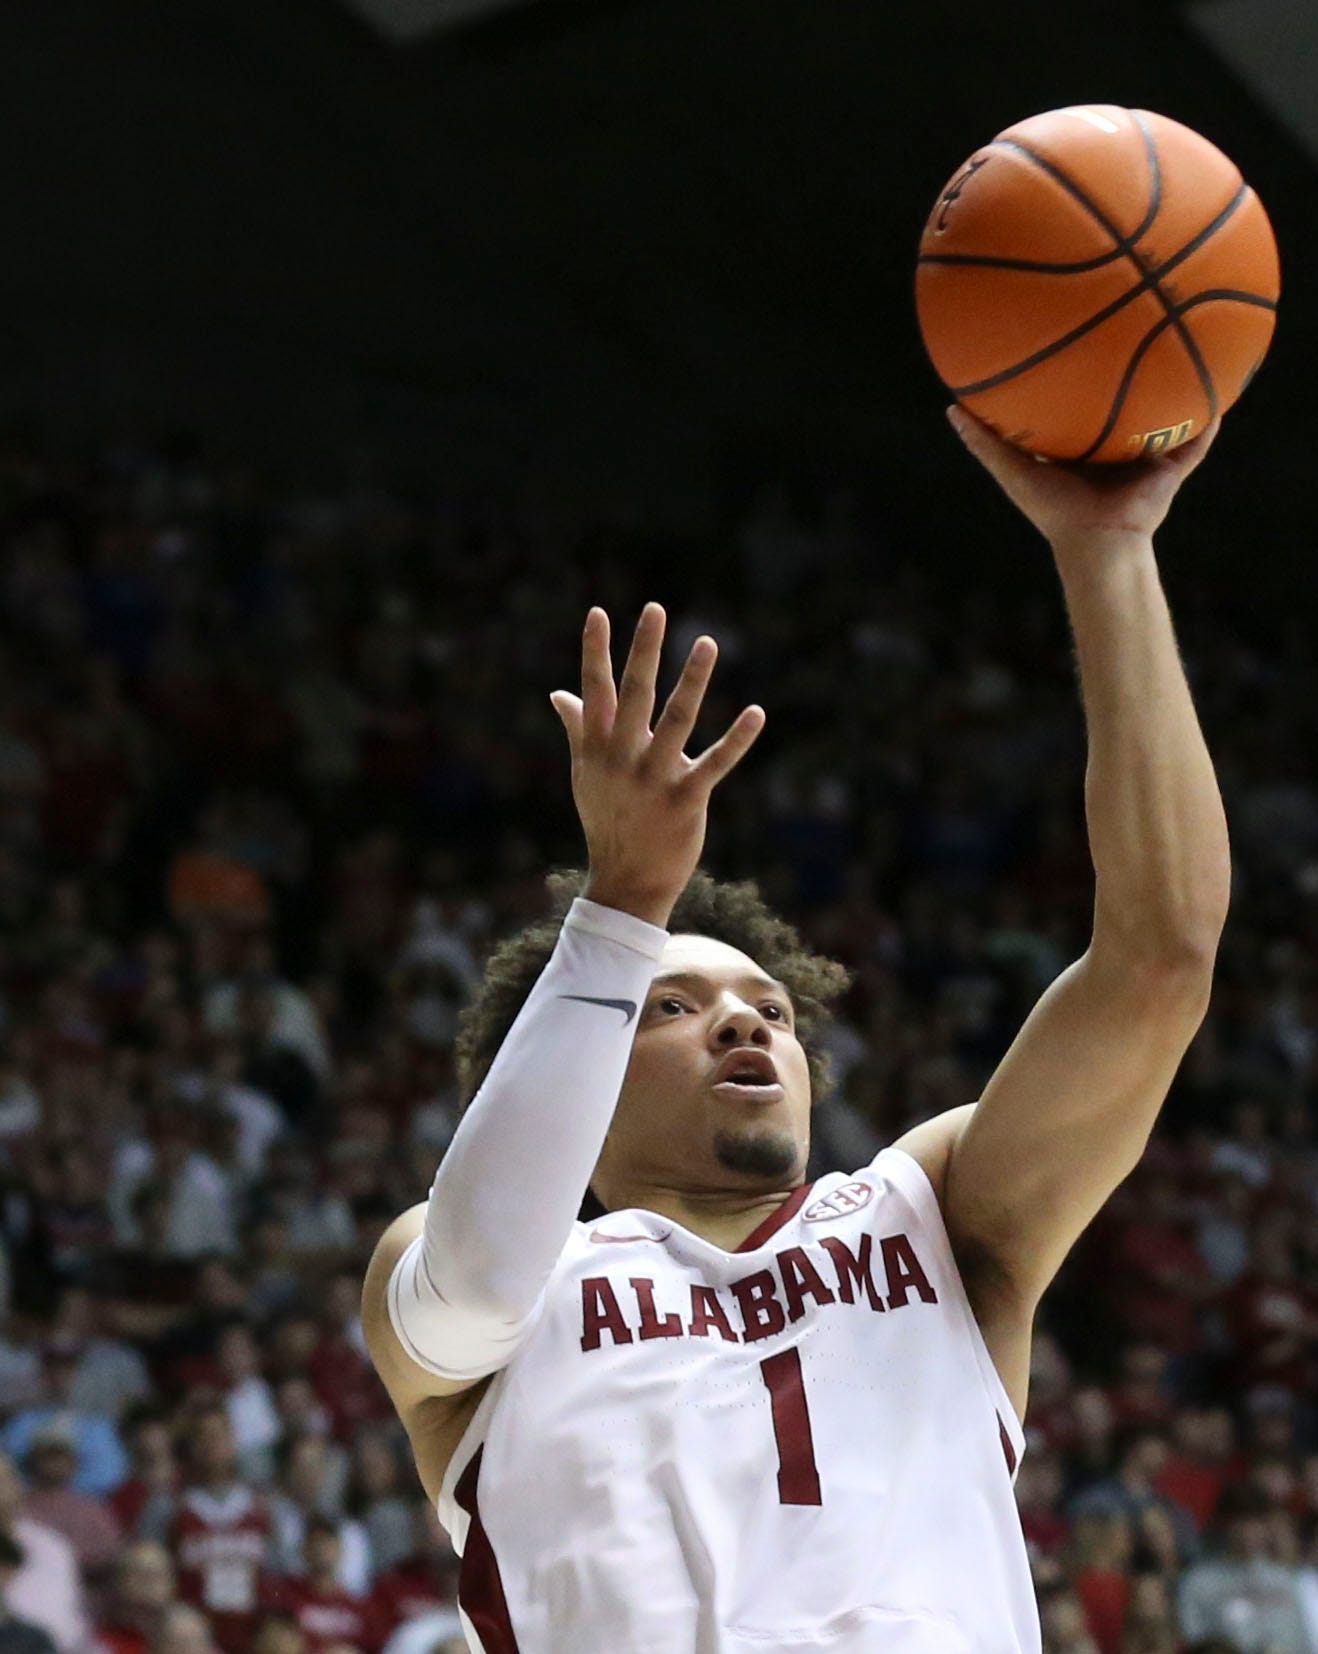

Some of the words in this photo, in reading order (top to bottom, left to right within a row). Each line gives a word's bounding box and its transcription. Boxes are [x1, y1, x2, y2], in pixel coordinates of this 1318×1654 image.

[804, 1182, 874, 1220] SEC
[579, 1231, 939, 1352] ALABAMA
[759, 1346, 823, 1506] 1
